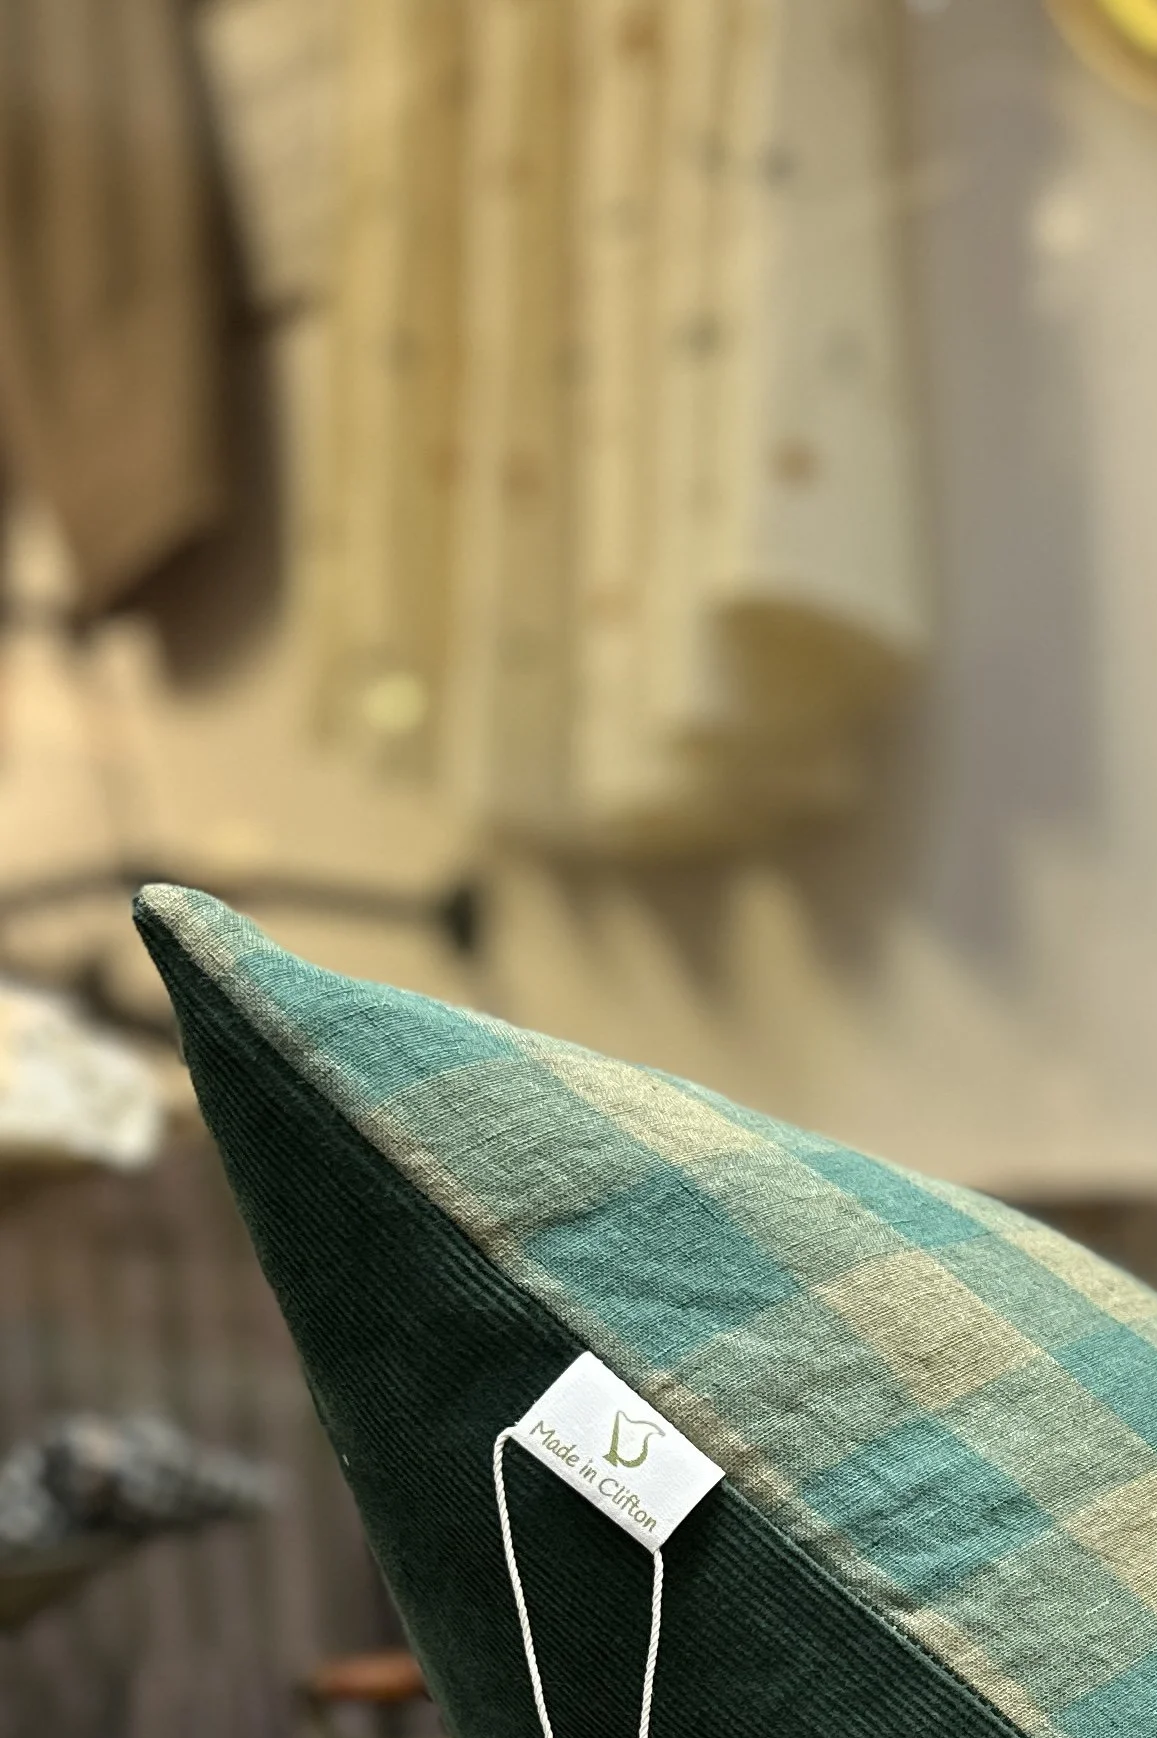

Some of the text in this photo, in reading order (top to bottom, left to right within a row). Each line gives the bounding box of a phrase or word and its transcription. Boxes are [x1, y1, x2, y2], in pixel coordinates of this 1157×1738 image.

[529, 1420, 657, 1533] Made in Clifton
